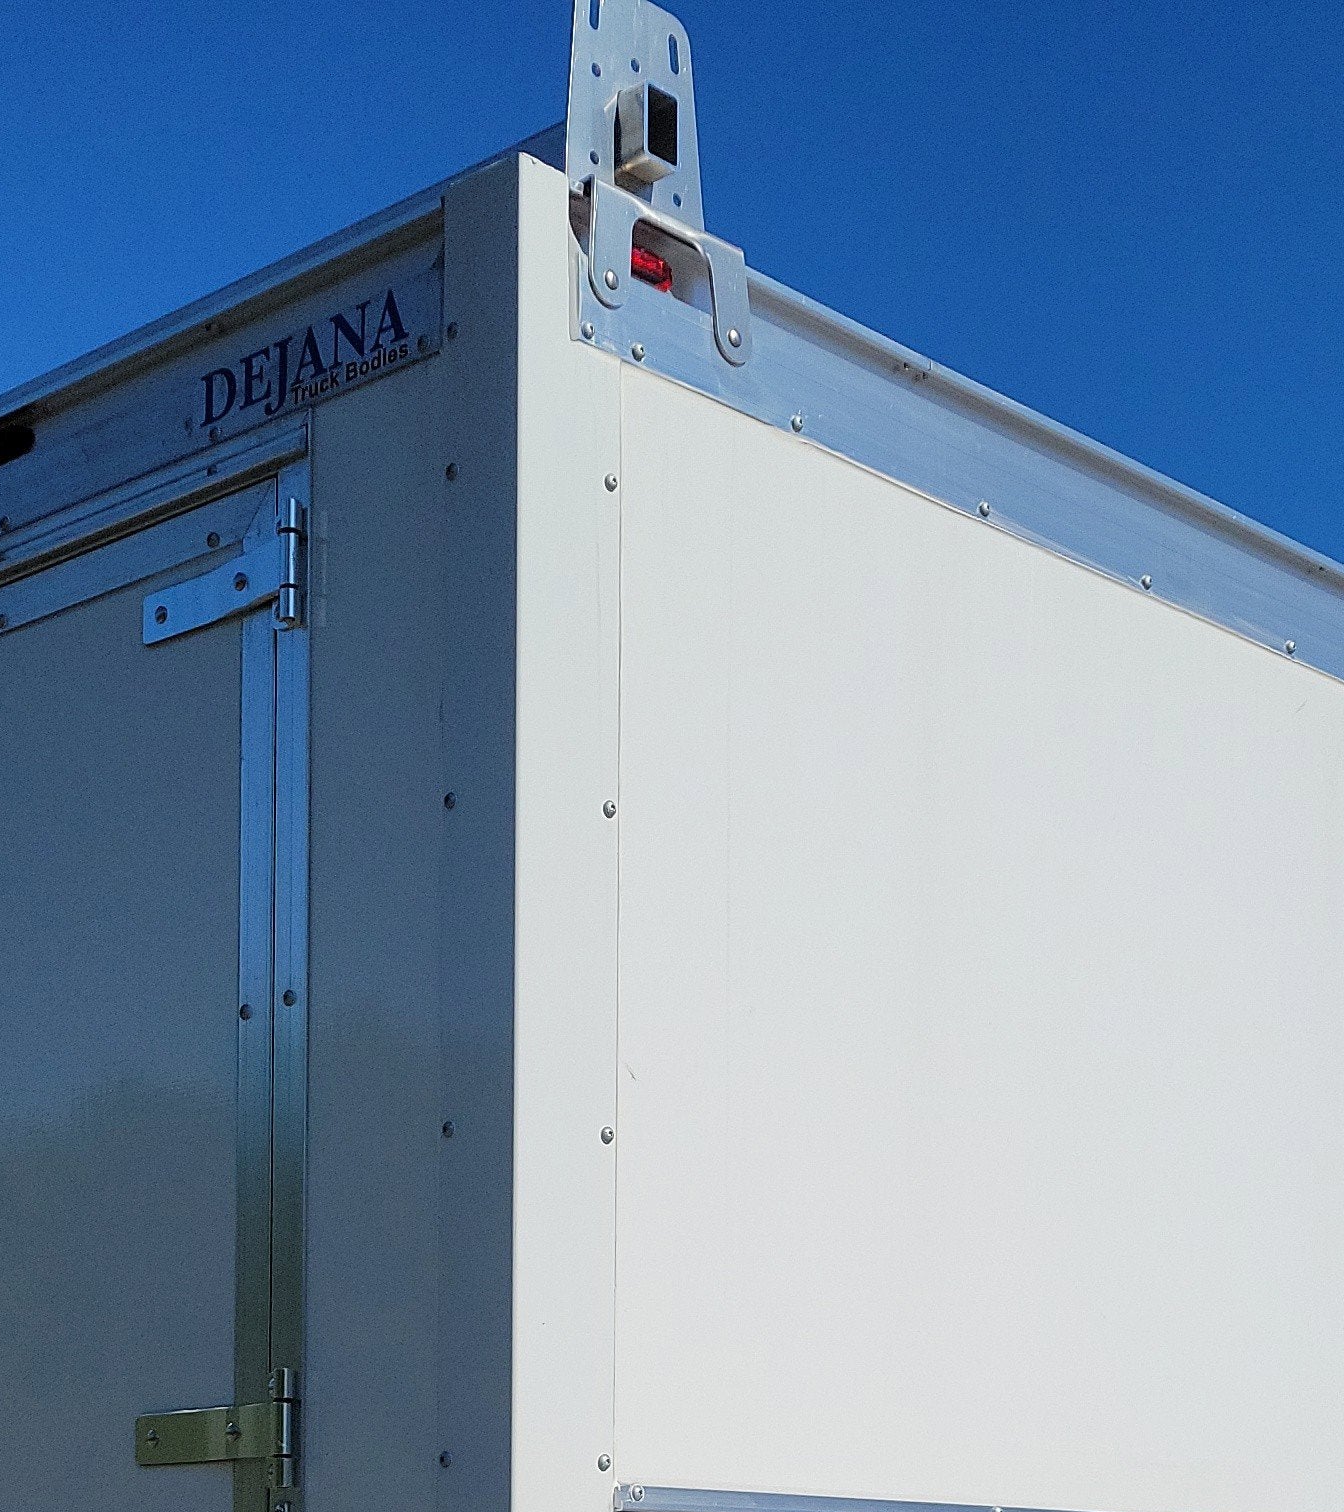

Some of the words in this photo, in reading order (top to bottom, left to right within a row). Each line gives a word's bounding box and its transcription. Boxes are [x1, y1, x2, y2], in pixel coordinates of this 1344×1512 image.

[200, 289, 409, 428] DEJANA
[291, 369, 340, 404] Truck
[345, 344, 409, 382] Bodies
